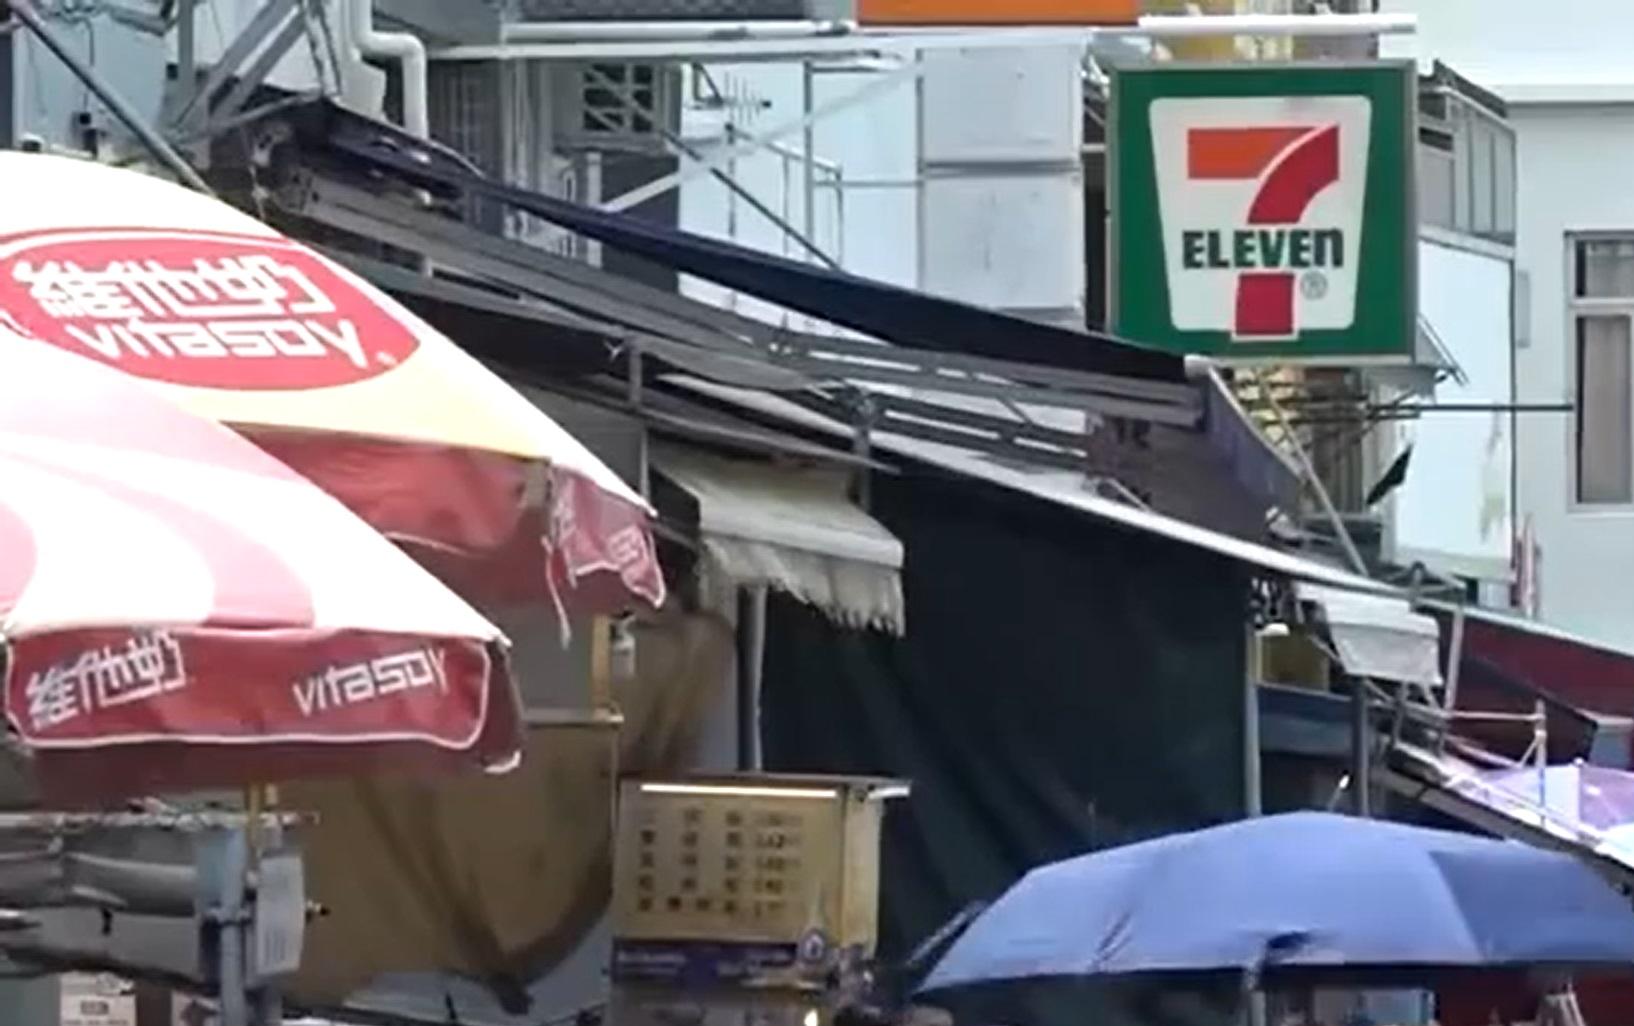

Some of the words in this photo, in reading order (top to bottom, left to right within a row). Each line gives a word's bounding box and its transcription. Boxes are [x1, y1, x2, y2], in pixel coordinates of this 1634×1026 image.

[12, 254, 335, 319] 維他奶
[65, 314, 369, 369] vitasoy
